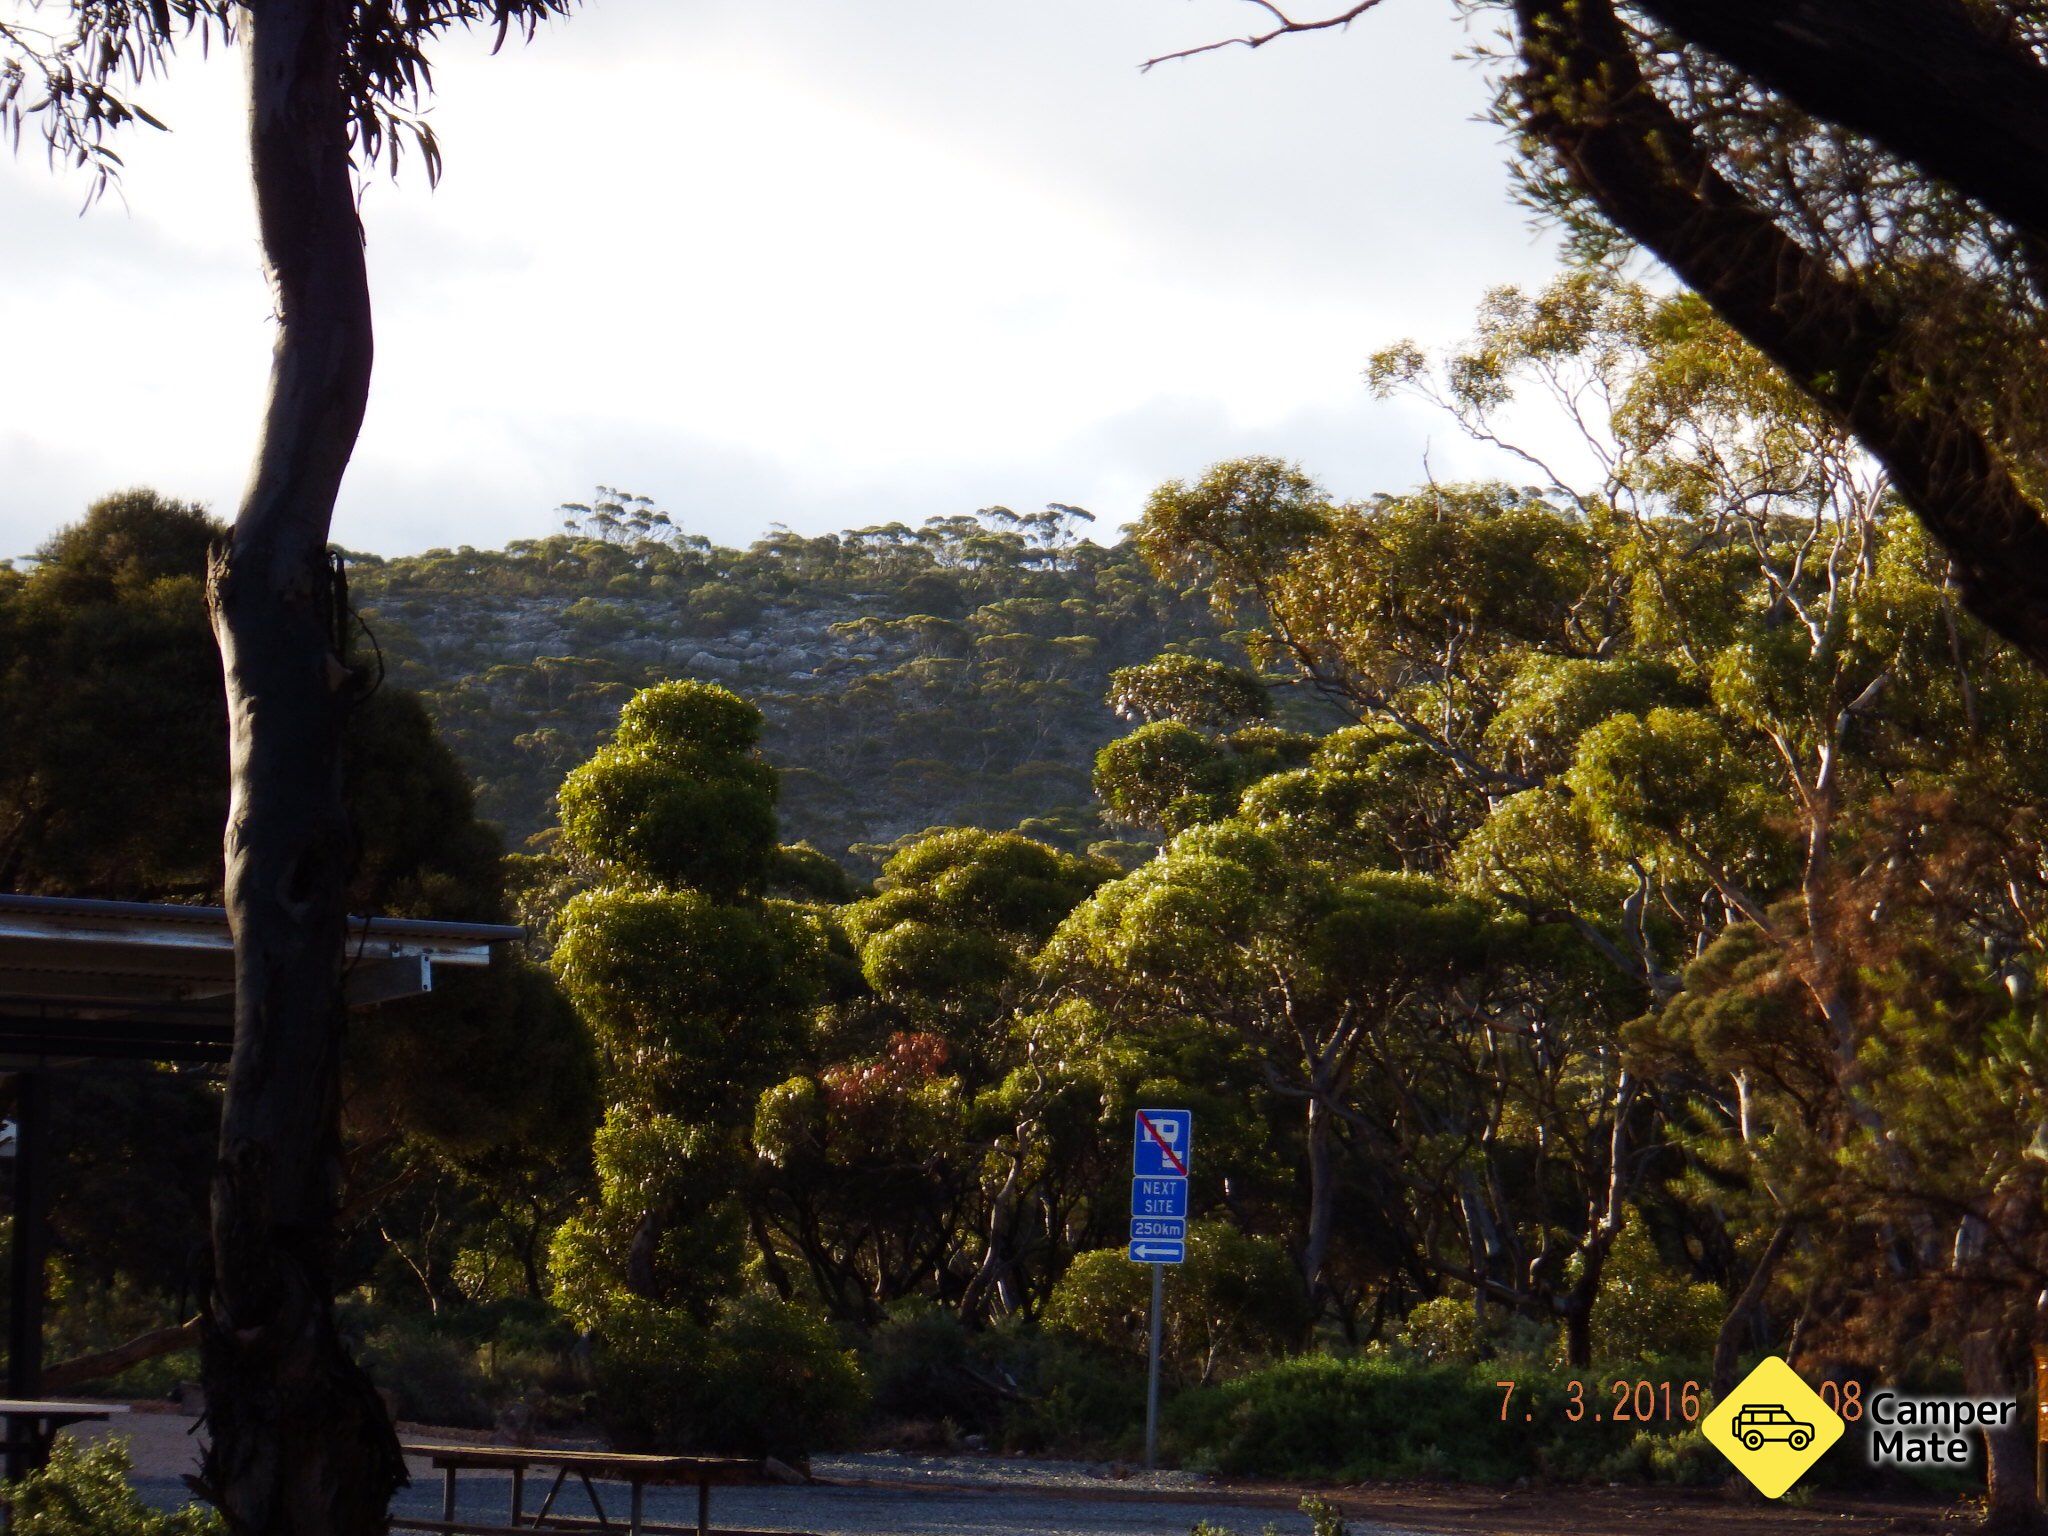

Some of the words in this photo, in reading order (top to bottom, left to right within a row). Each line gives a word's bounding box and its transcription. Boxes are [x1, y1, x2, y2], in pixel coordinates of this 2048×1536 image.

[1143, 1181, 1177, 1195] NEXT
[1144, 1199, 1174, 1213] SITE
[1135, 1222, 1181, 1236] 250km
